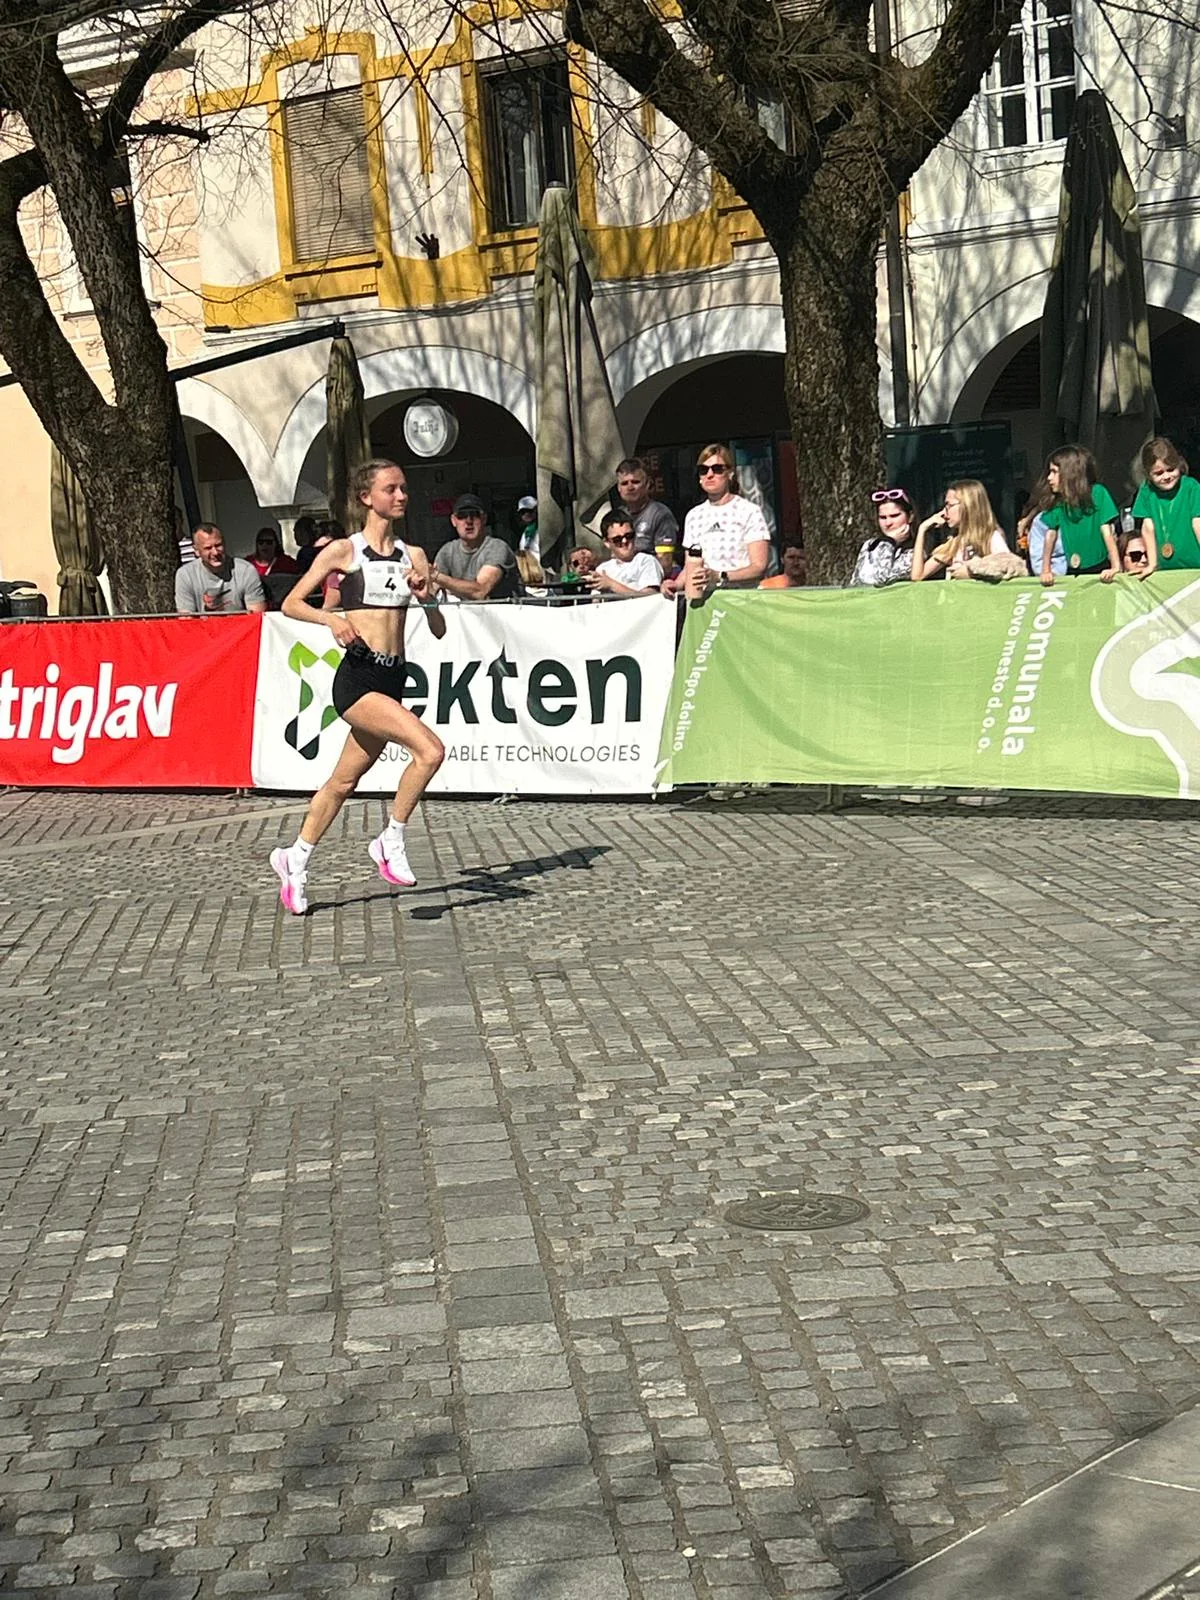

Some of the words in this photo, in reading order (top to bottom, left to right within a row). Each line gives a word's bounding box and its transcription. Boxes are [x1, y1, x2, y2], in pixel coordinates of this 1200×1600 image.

[385, 577, 396, 591] 4
[709, 609, 726, 627] Za
[1007, 592, 1032, 636] Novo
[695, 629, 719, 663] mojo
[684, 666, 708, 698] lepo
[991, 640, 1017, 693] mesto
[1000, 591, 1067, 756] Komunala
[0, 662, 178, 765] triglav
[379, 744, 488, 761] SUSABLE
[495, 744, 641, 762] TECHNOLOGIES
